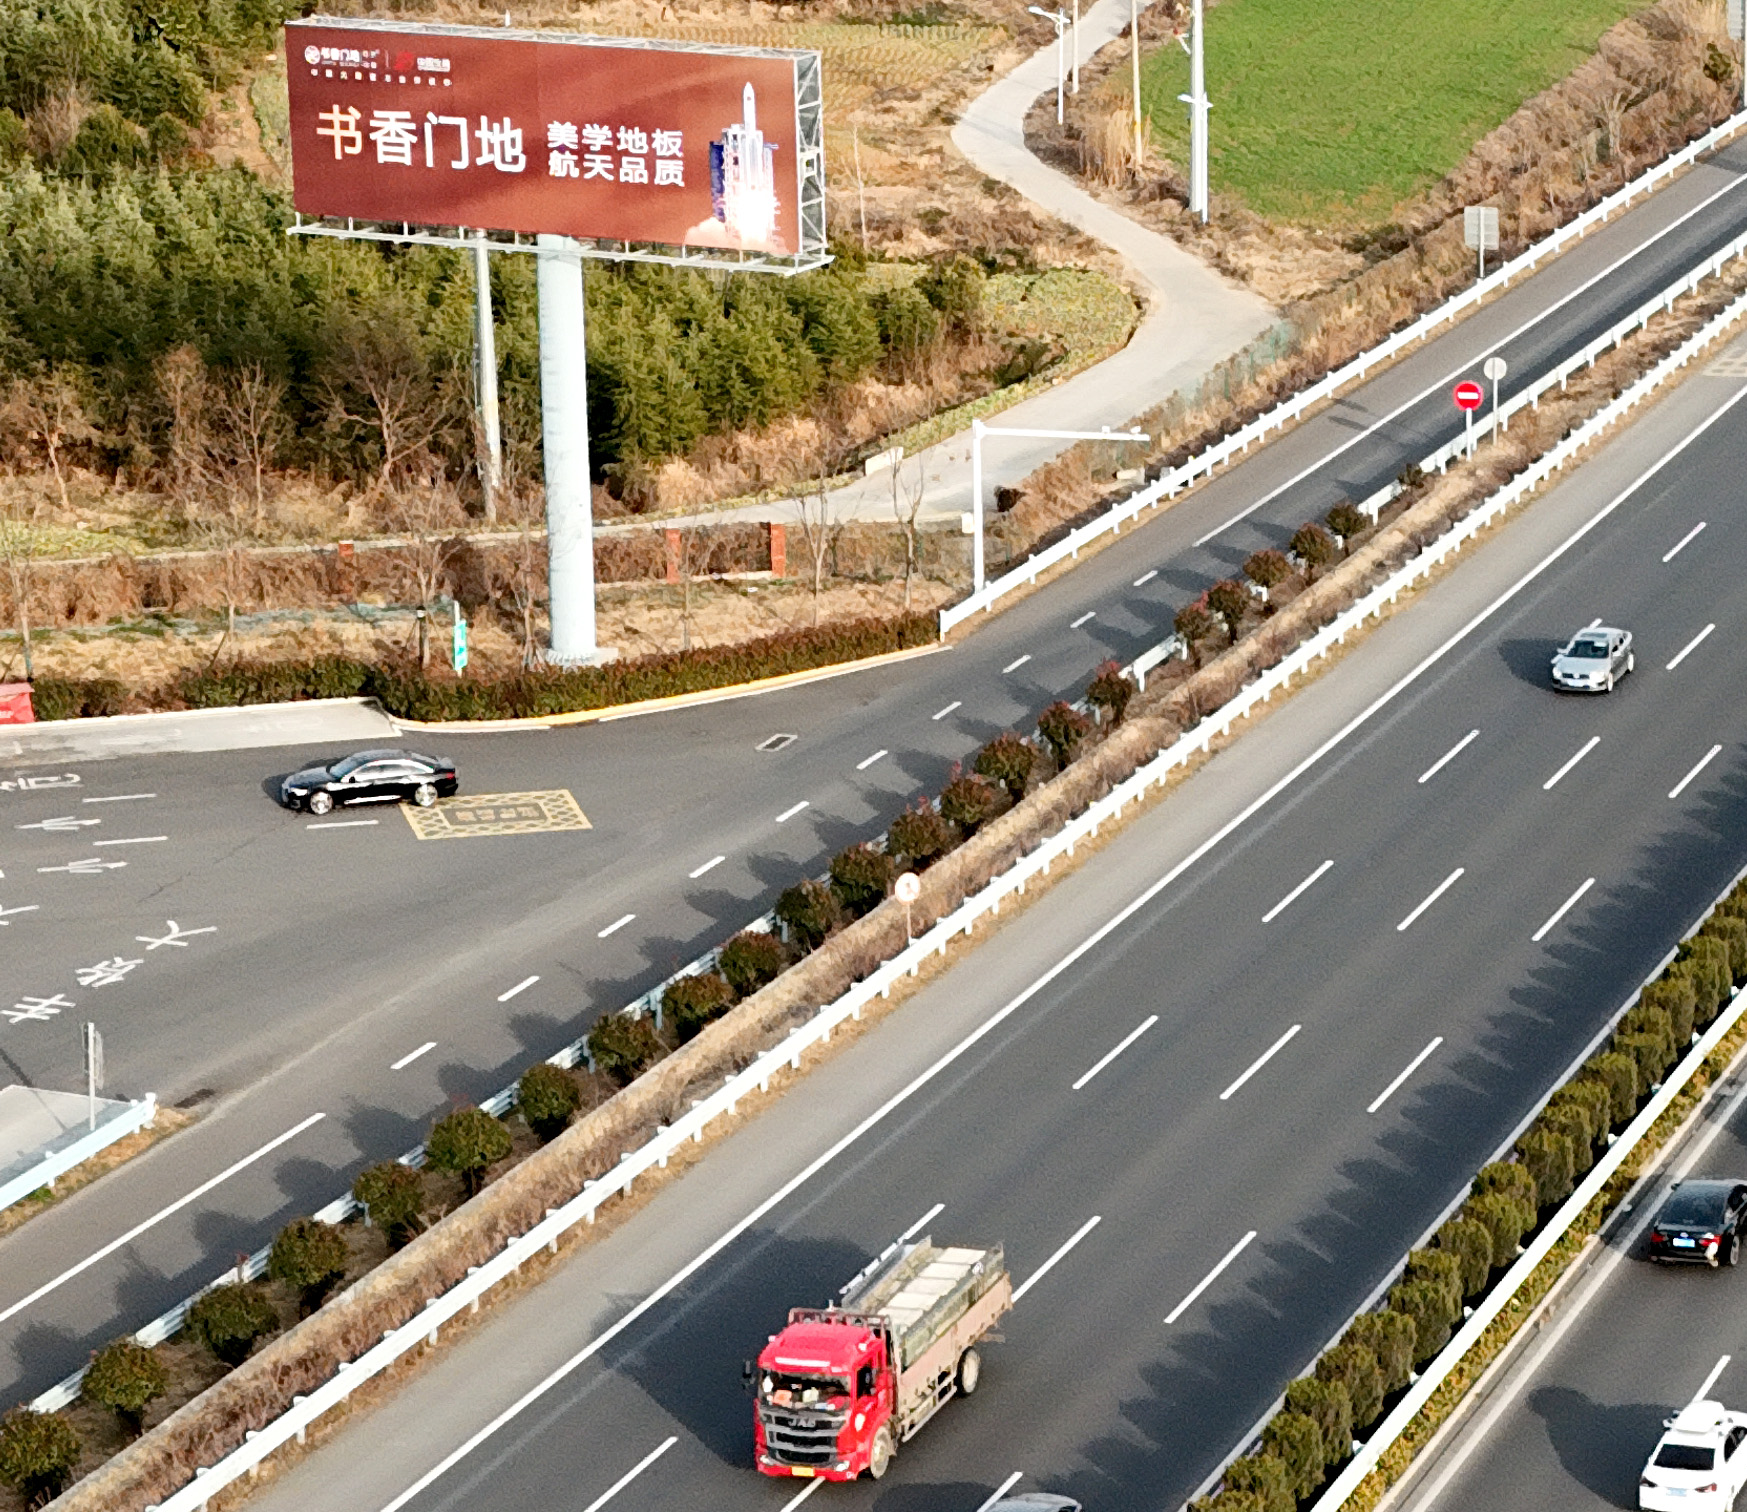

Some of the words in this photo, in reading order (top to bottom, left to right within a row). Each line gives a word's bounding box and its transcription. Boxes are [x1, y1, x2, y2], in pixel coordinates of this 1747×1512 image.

[316, 104, 527, 173] 书香门地
[547, 120, 685, 158] 美学地板
[548, 150, 686, 188] 航天品质
